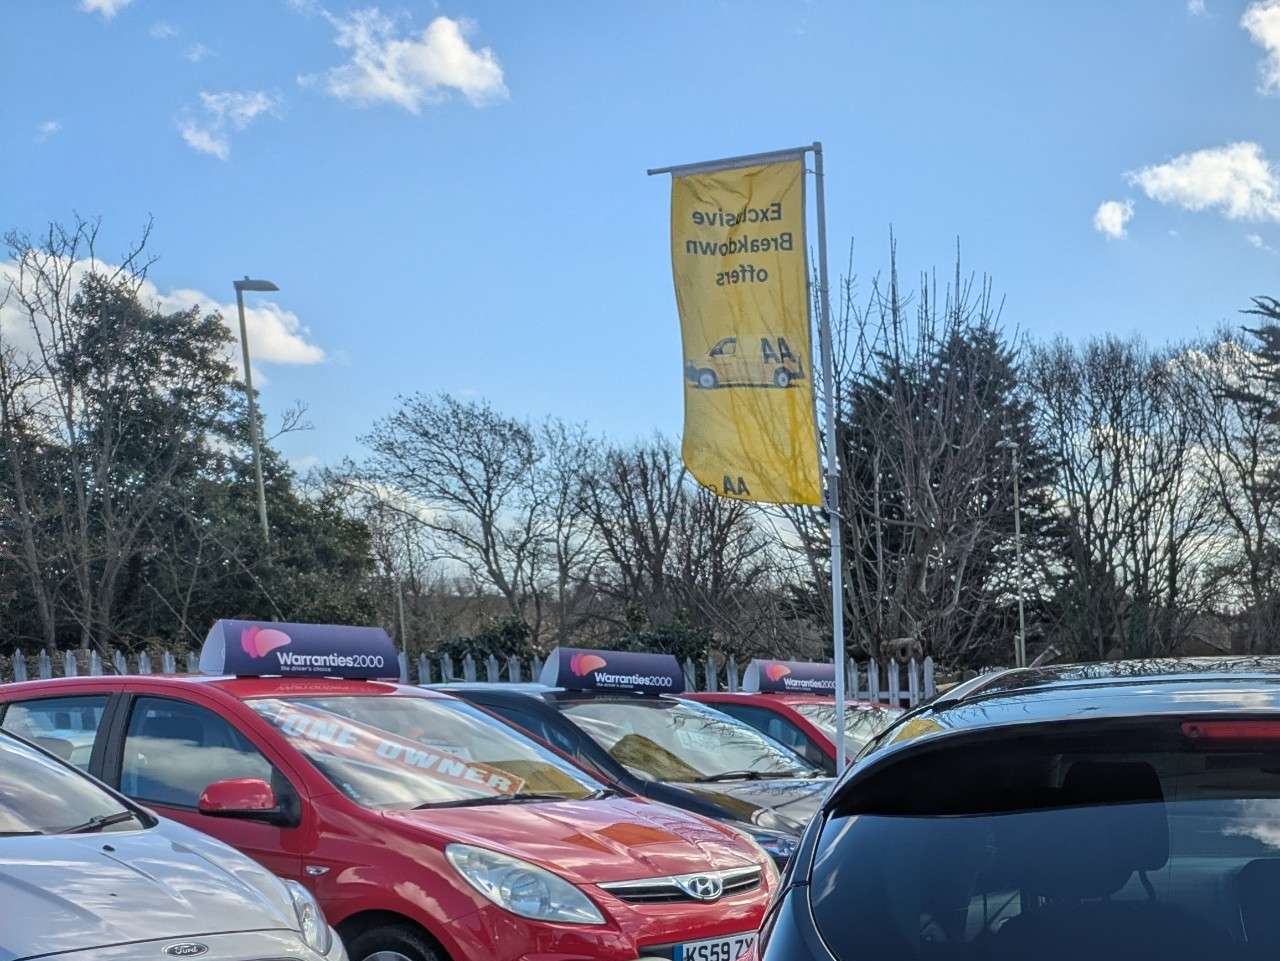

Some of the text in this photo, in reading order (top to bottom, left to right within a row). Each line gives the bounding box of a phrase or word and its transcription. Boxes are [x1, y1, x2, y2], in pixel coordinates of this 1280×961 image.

[277, 652, 384, 668] Warranties2000
[594, 672, 672, 687] Warranties2000
[280, 712, 513, 793] ONE OWNER
